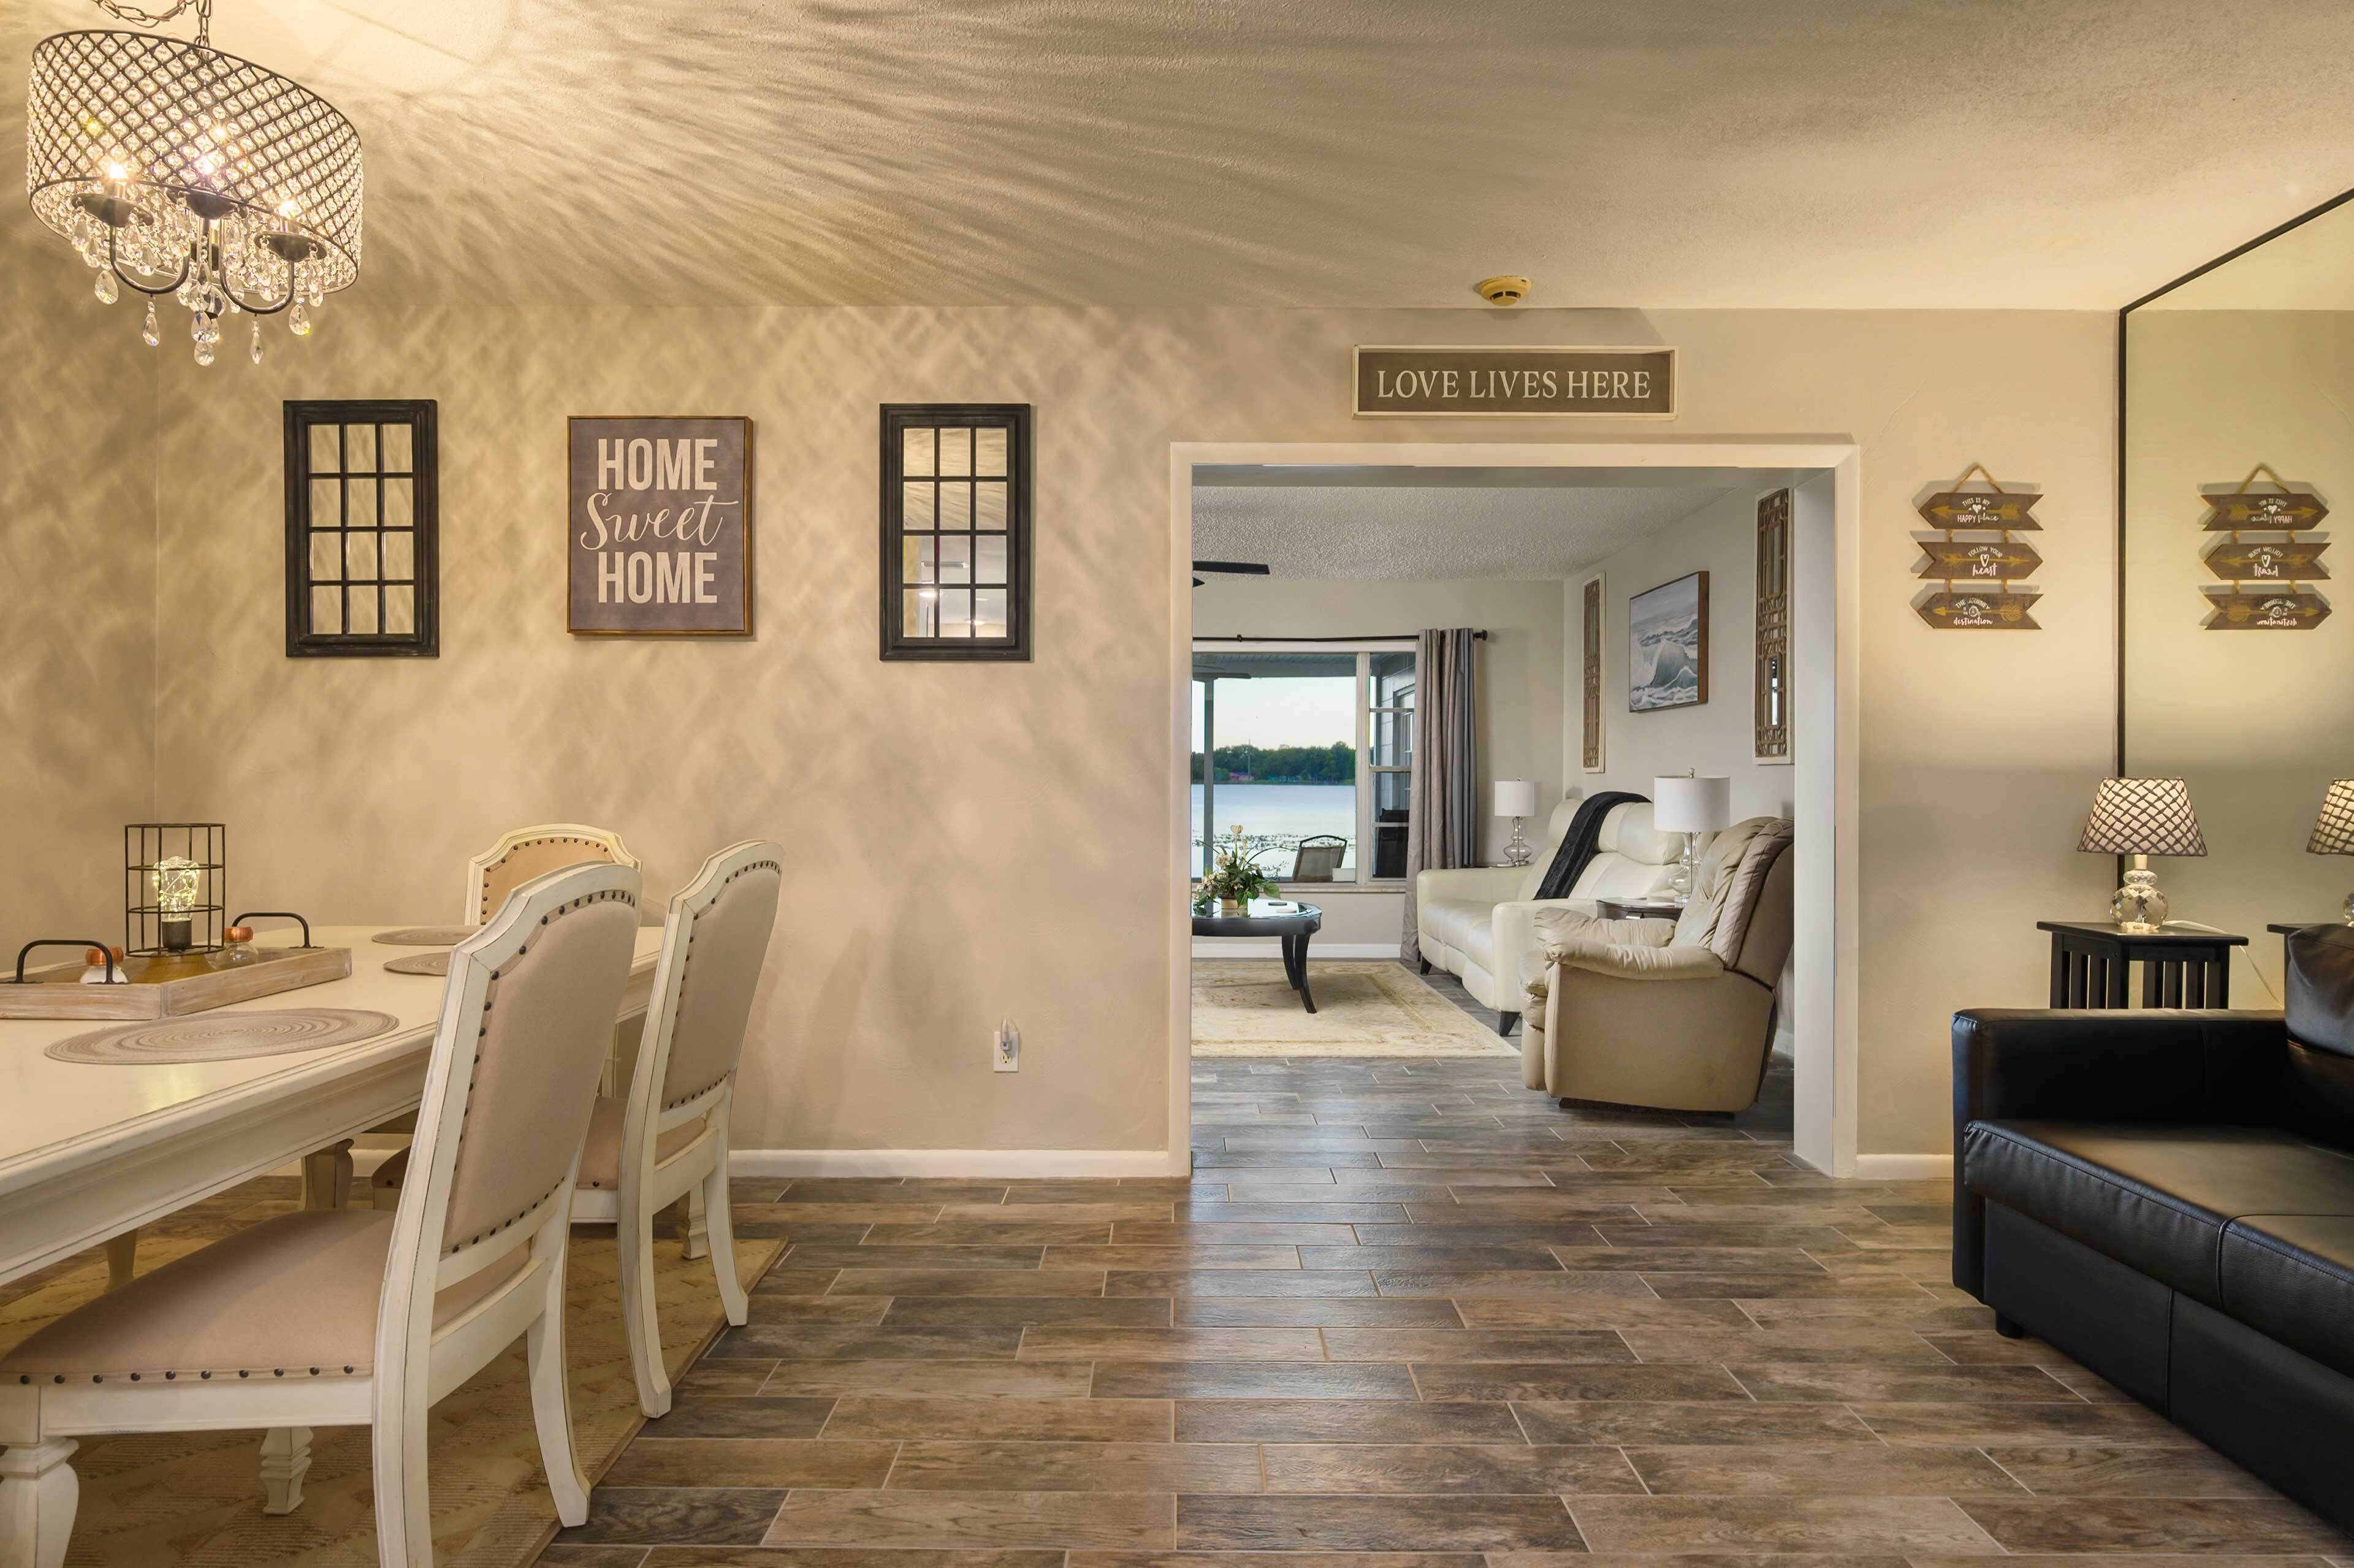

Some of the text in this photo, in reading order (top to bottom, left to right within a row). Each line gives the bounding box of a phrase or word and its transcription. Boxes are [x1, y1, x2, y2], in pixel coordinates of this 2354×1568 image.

[1377, 370, 1651, 399] LOVE LIVES HERE
[598, 438, 718, 490] HOME
[1962, 497, 1974, 507] THIS
[580, 492, 739, 550] Sweet
[1957, 514, 1976, 523] HAPPY
[1968, 546, 2003, 558] FOLLOW YOUR
[1972, 562, 1998, 577] heart
[598, 551, 718, 604] HOME
[1955, 597, 1990, 610] THE JOURNEY
[1953, 616, 1994, 626] destination
